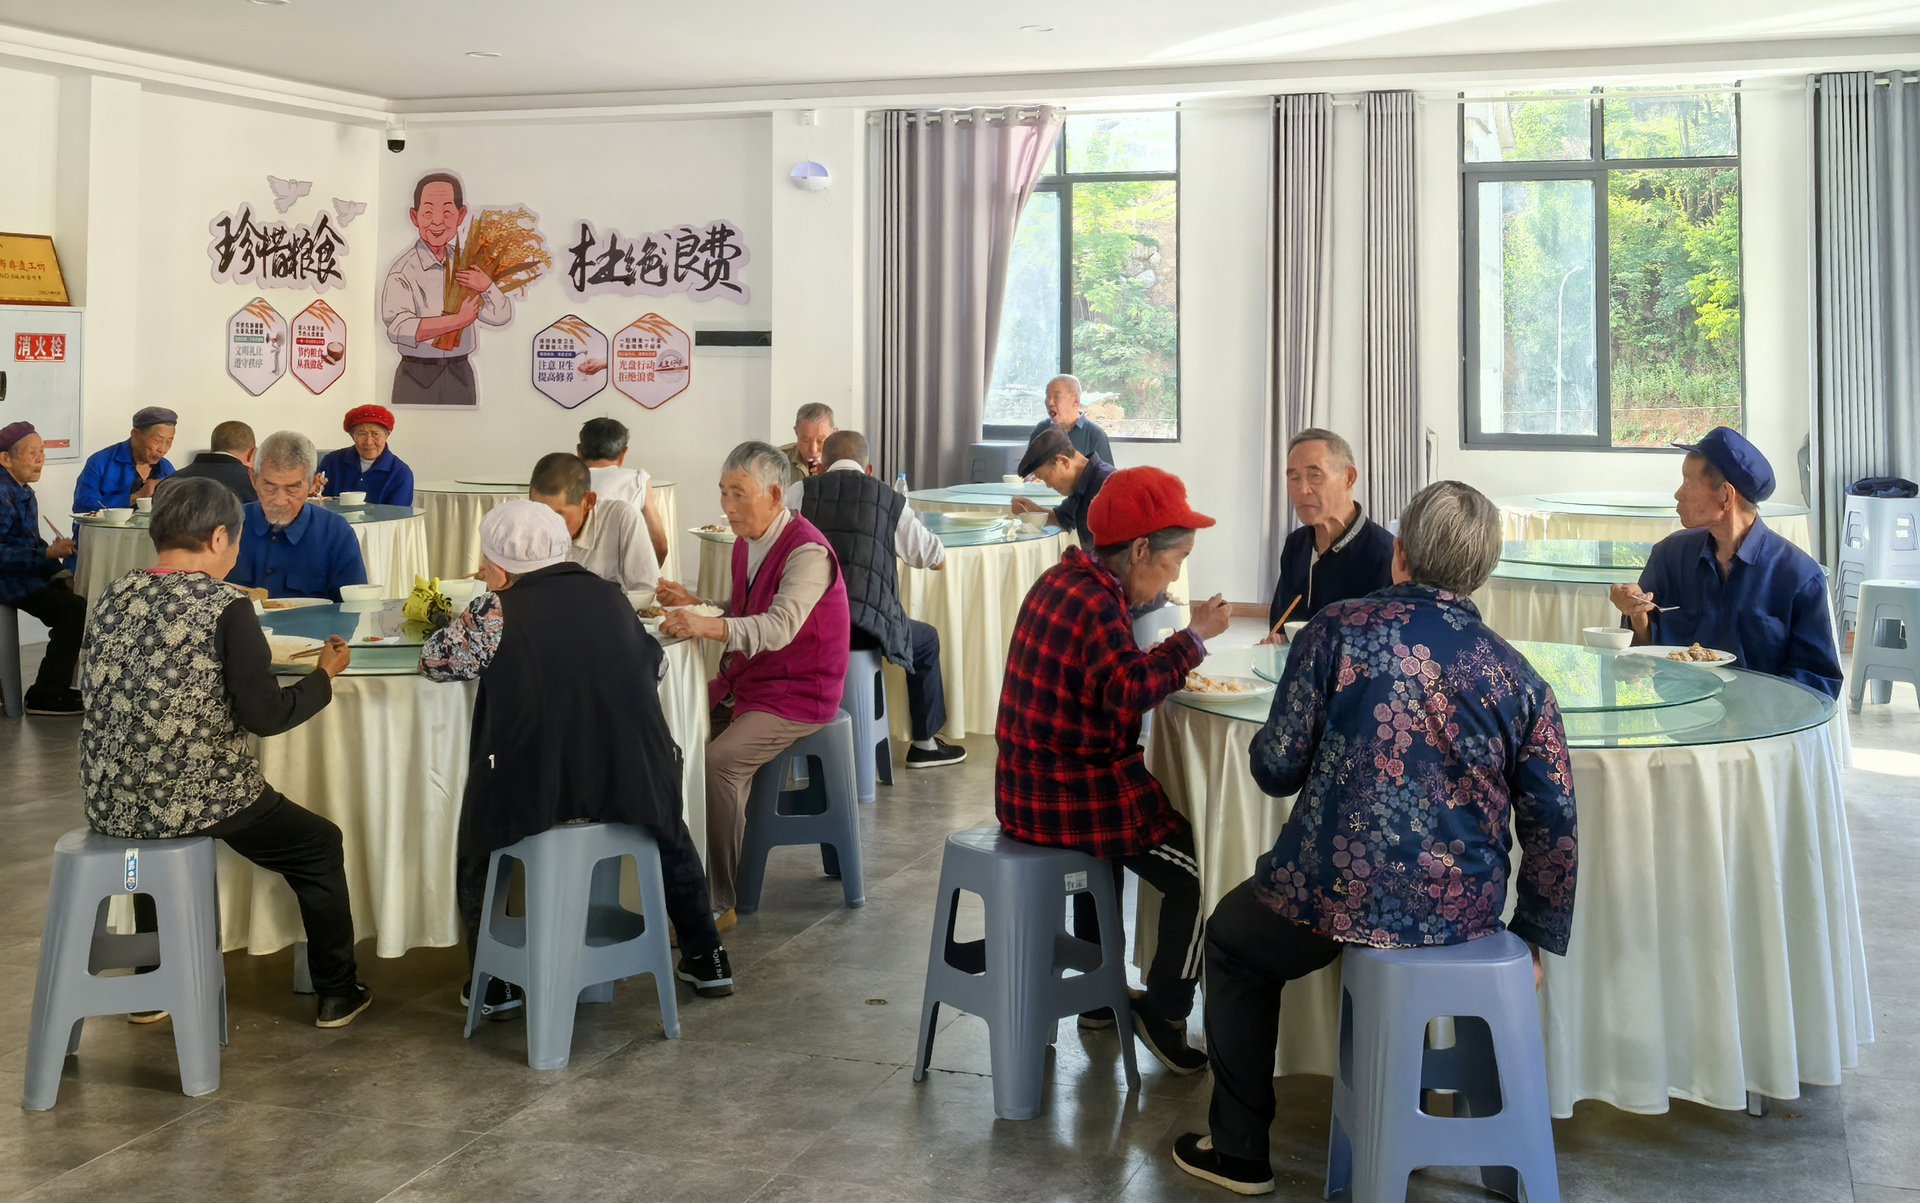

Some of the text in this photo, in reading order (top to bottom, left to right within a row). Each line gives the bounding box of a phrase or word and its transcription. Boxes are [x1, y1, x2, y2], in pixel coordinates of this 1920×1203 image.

[214, 206, 345, 284] 珍惜粮食
[568, 223, 743, 293] 杜绝浪费
[18, 335, 63, 358] 消火栓
[235, 345, 263, 356] 文明礼让
[298, 346, 324, 358] 节约粮食
[234, 357, 263, 369] 遵守秩序
[297, 358, 324, 370] 从我做起
[538, 360, 574, 371] 注意卫生
[619, 360, 656, 370] 光盘行动
[538, 371, 574, 382] 提高修养
[618, 371, 655, 382] 拒绝浪费
